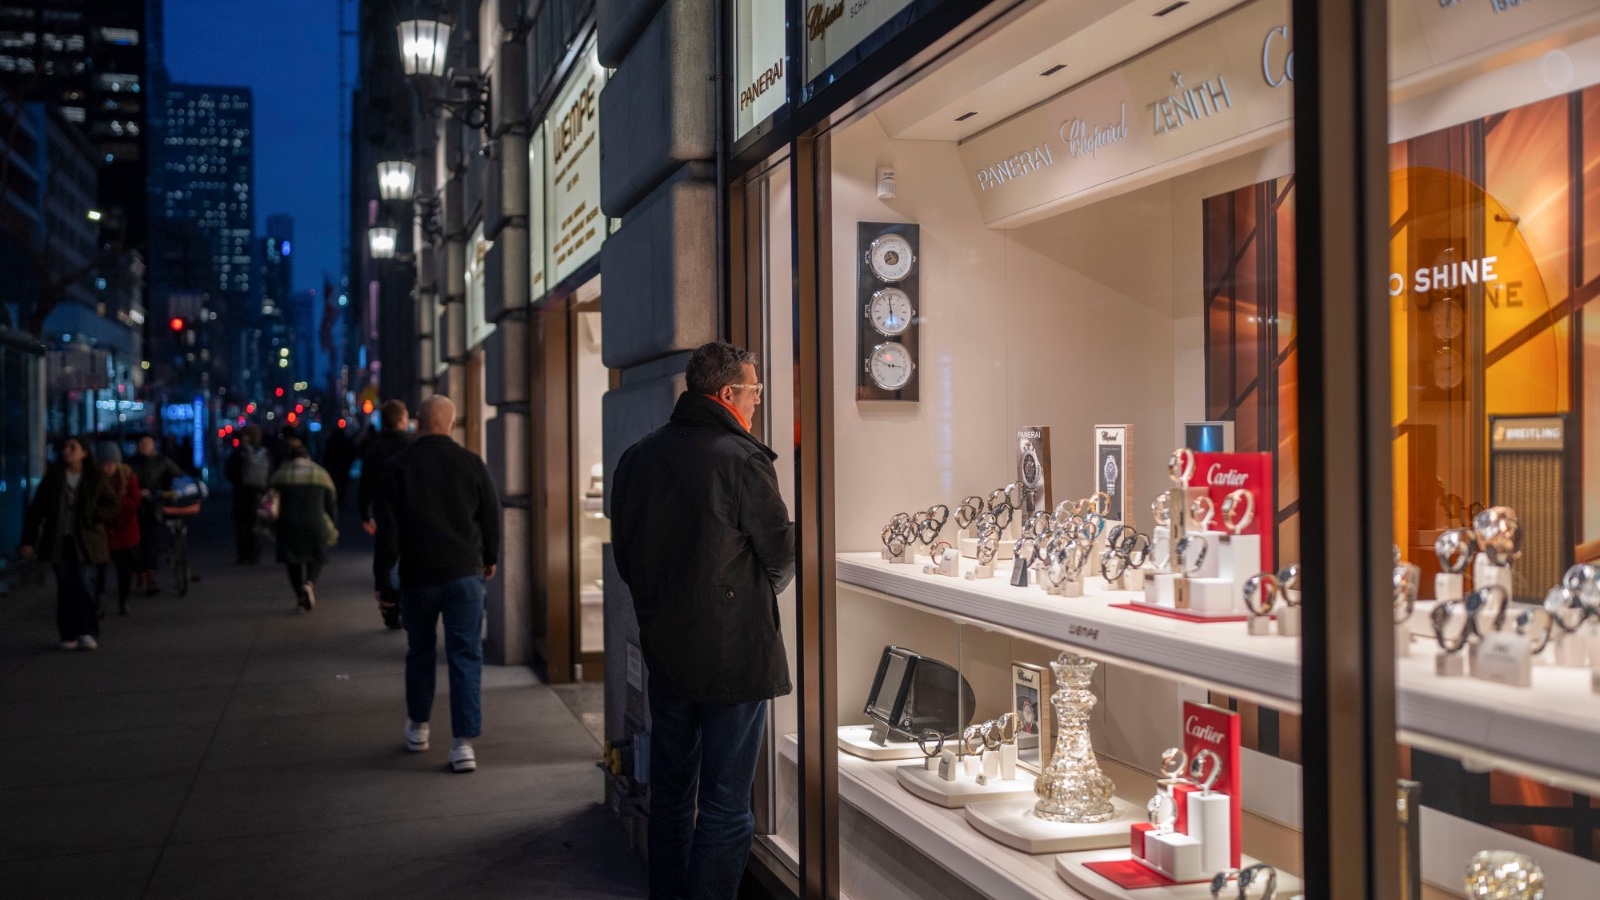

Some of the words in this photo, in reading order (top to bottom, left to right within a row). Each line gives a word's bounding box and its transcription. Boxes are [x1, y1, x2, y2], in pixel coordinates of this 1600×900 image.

[739, 58, 784, 112] PANERAI
[1147, 75, 1233, 136] ZENITH
[1060, 101, 1128, 160] Chopard
[976, 143, 1054, 191] PANERAI
[1414, 256, 1498, 293] SHINE
[1017, 431, 1041, 439] PANERAI
[1506, 427, 1561, 441] BREITLING
[1206, 462, 1249, 487] Cartier
[1185, 714, 1226, 744] Cartier
